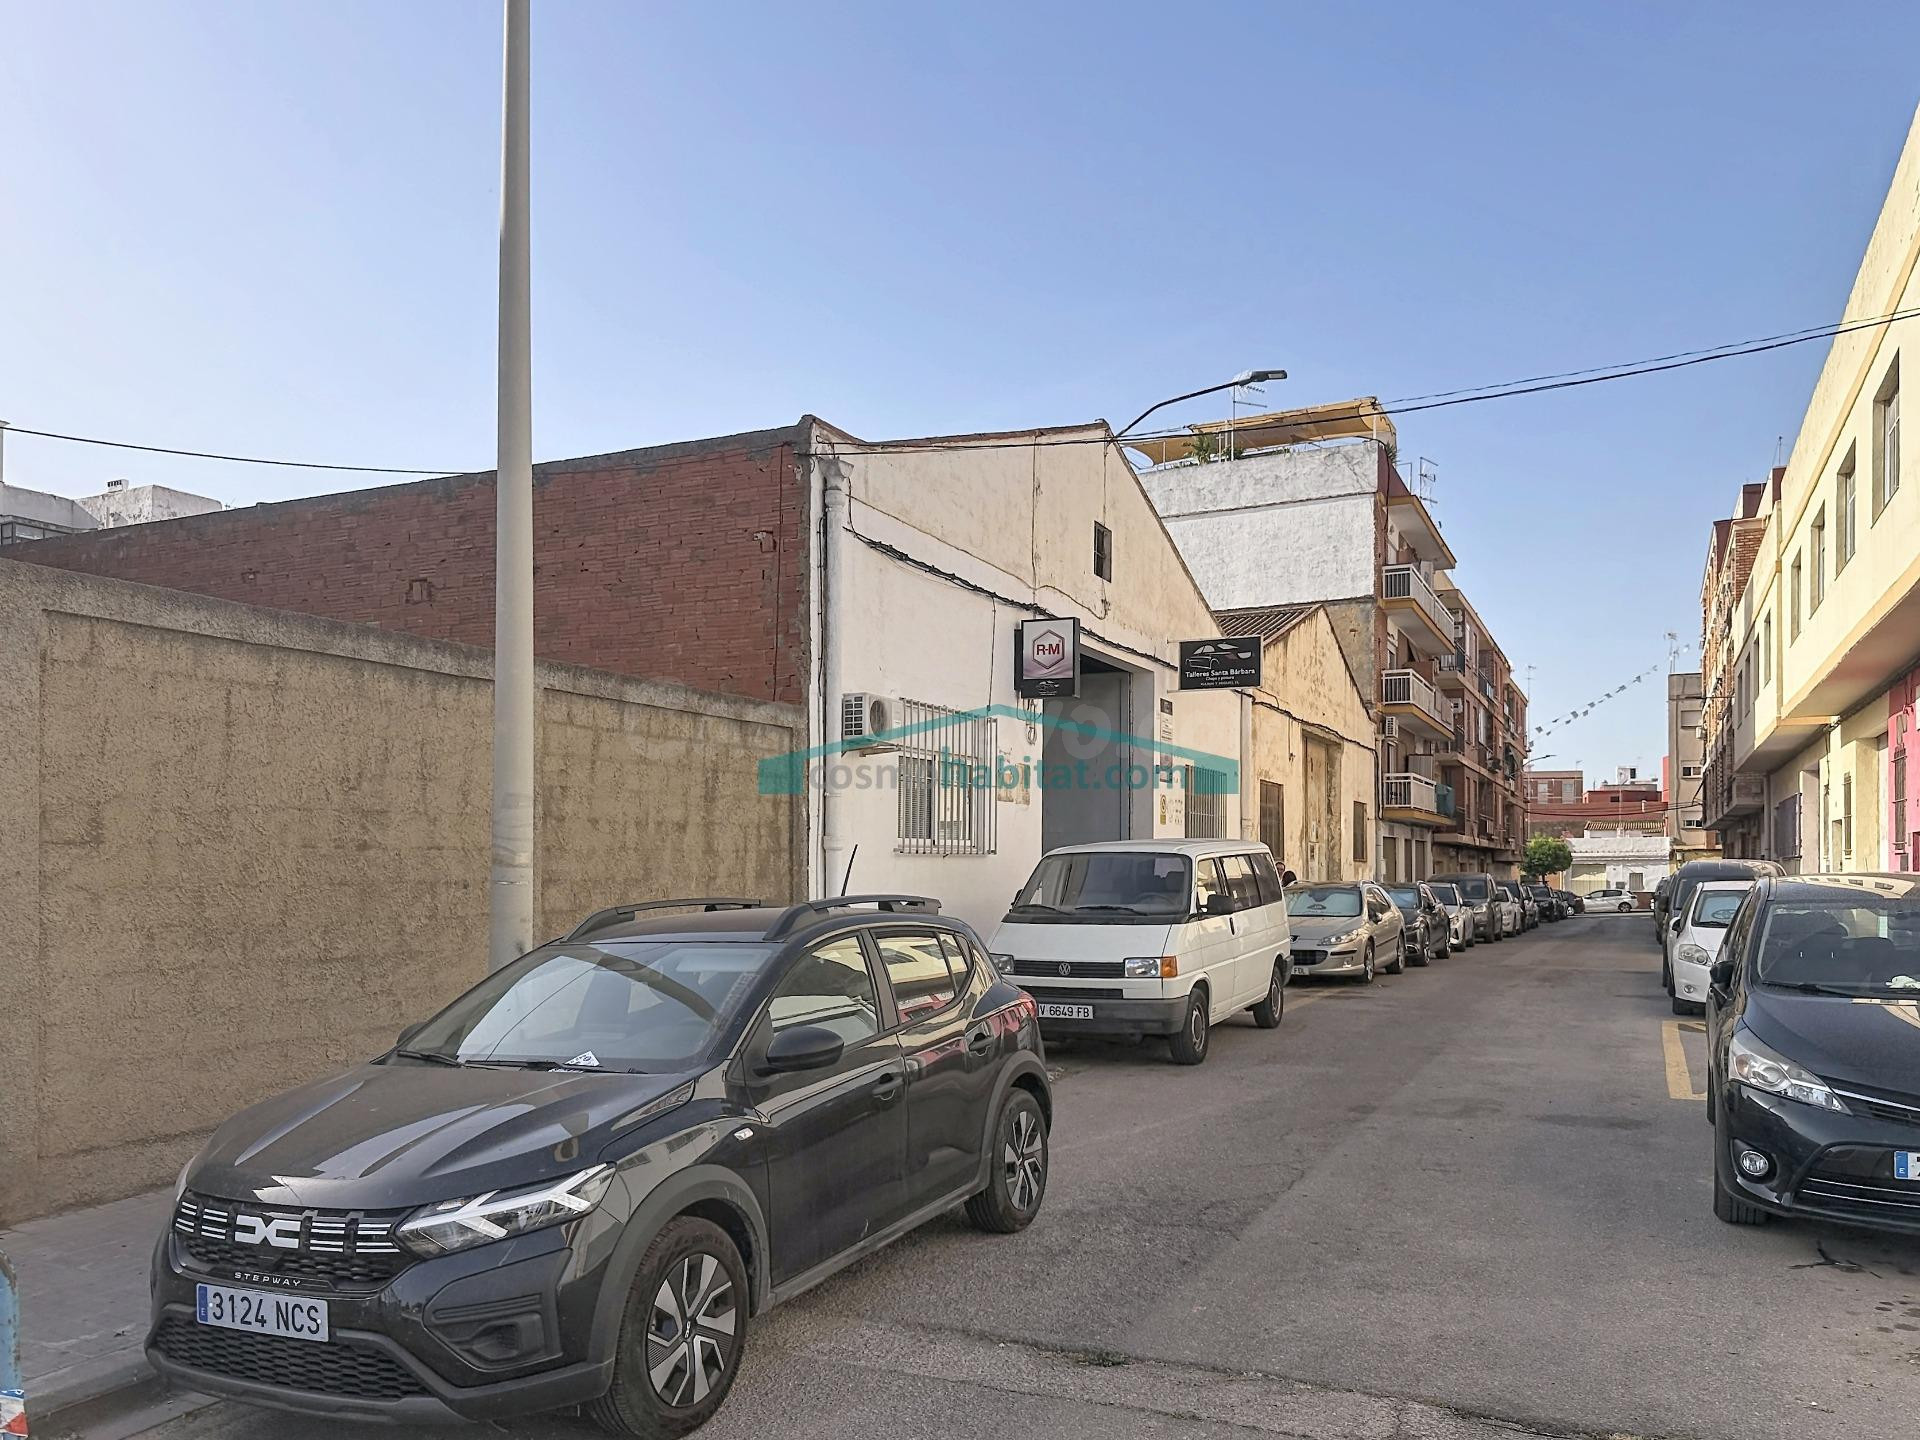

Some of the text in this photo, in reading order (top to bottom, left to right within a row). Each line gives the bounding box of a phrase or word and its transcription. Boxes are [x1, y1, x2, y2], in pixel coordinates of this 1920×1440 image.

[1036, 644, 1060, 655] R-M
[1039, 1004, 1090, 1018] V 6649 FB
[234, 1271, 301, 1287] STEPWAY
[212, 1291, 267, 1328] 3124
[275, 1300, 321, 1335] NCS
